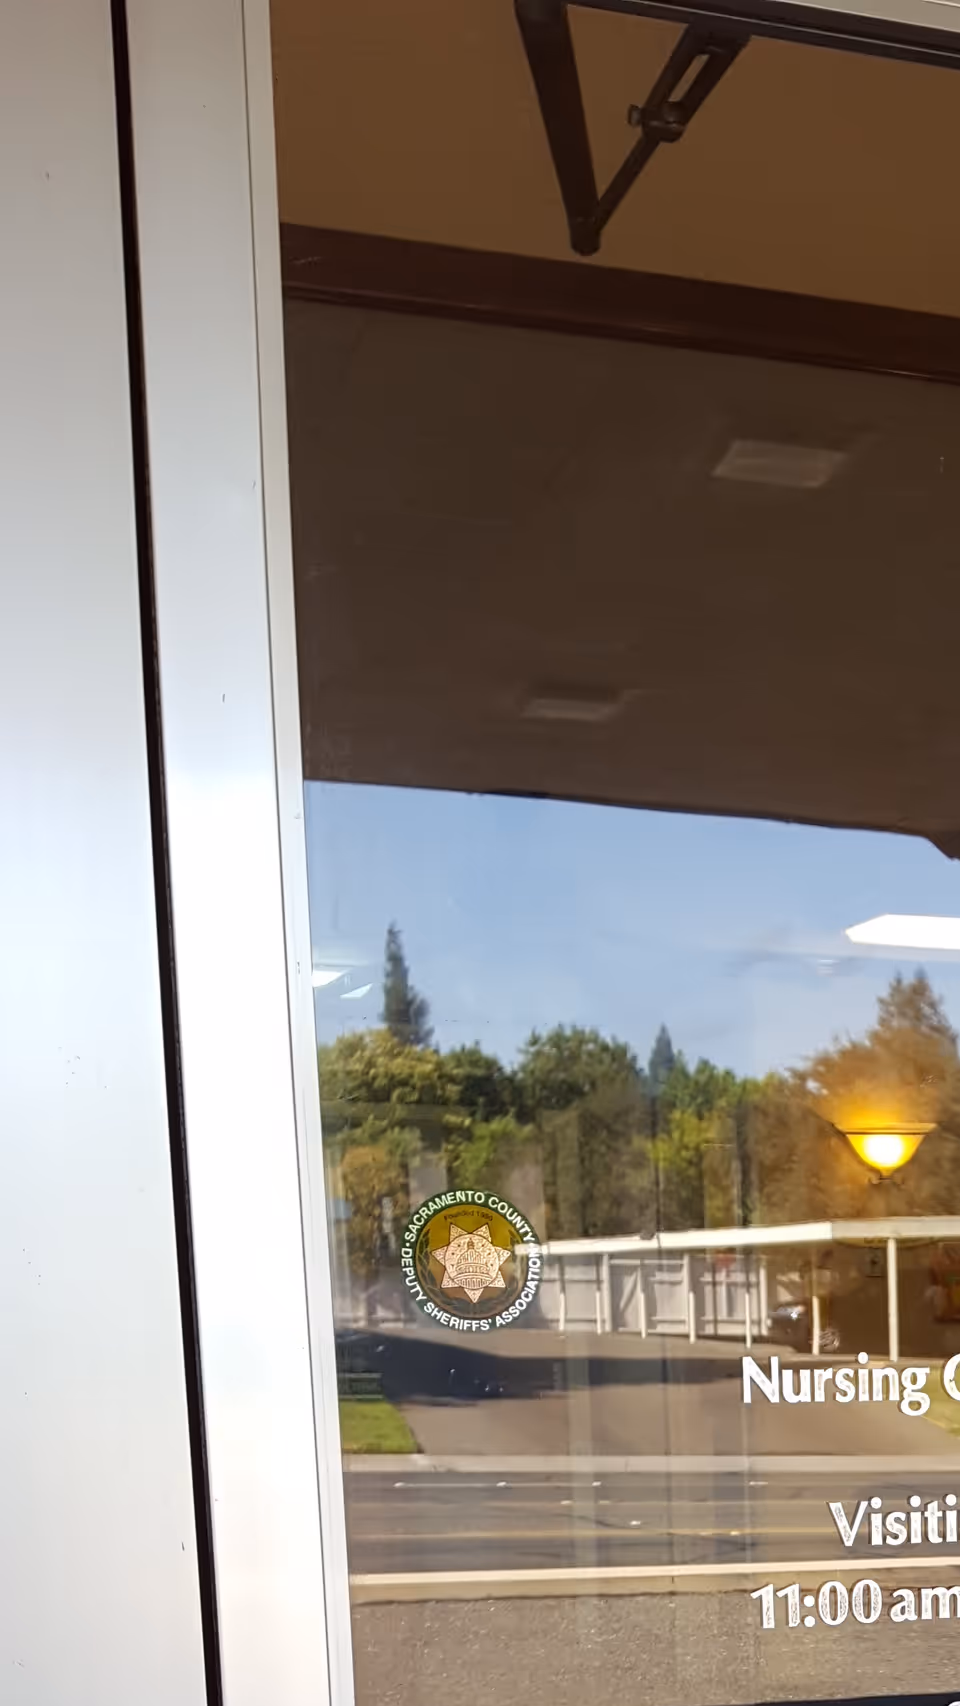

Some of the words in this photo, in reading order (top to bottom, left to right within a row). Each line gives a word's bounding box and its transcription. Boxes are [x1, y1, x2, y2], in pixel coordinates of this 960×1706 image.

[404, 1191, 485, 1242] SACRAMENTO
[488, 1196, 536, 1242] COUNTY
[402, 1248, 427, 1301] DEPUTY
[423, 1302, 492, 1332] SHERIFFS'
[495, 1246, 541, 1328] ASSOCIATION
[741, 1352, 931, 1417] Nursing
